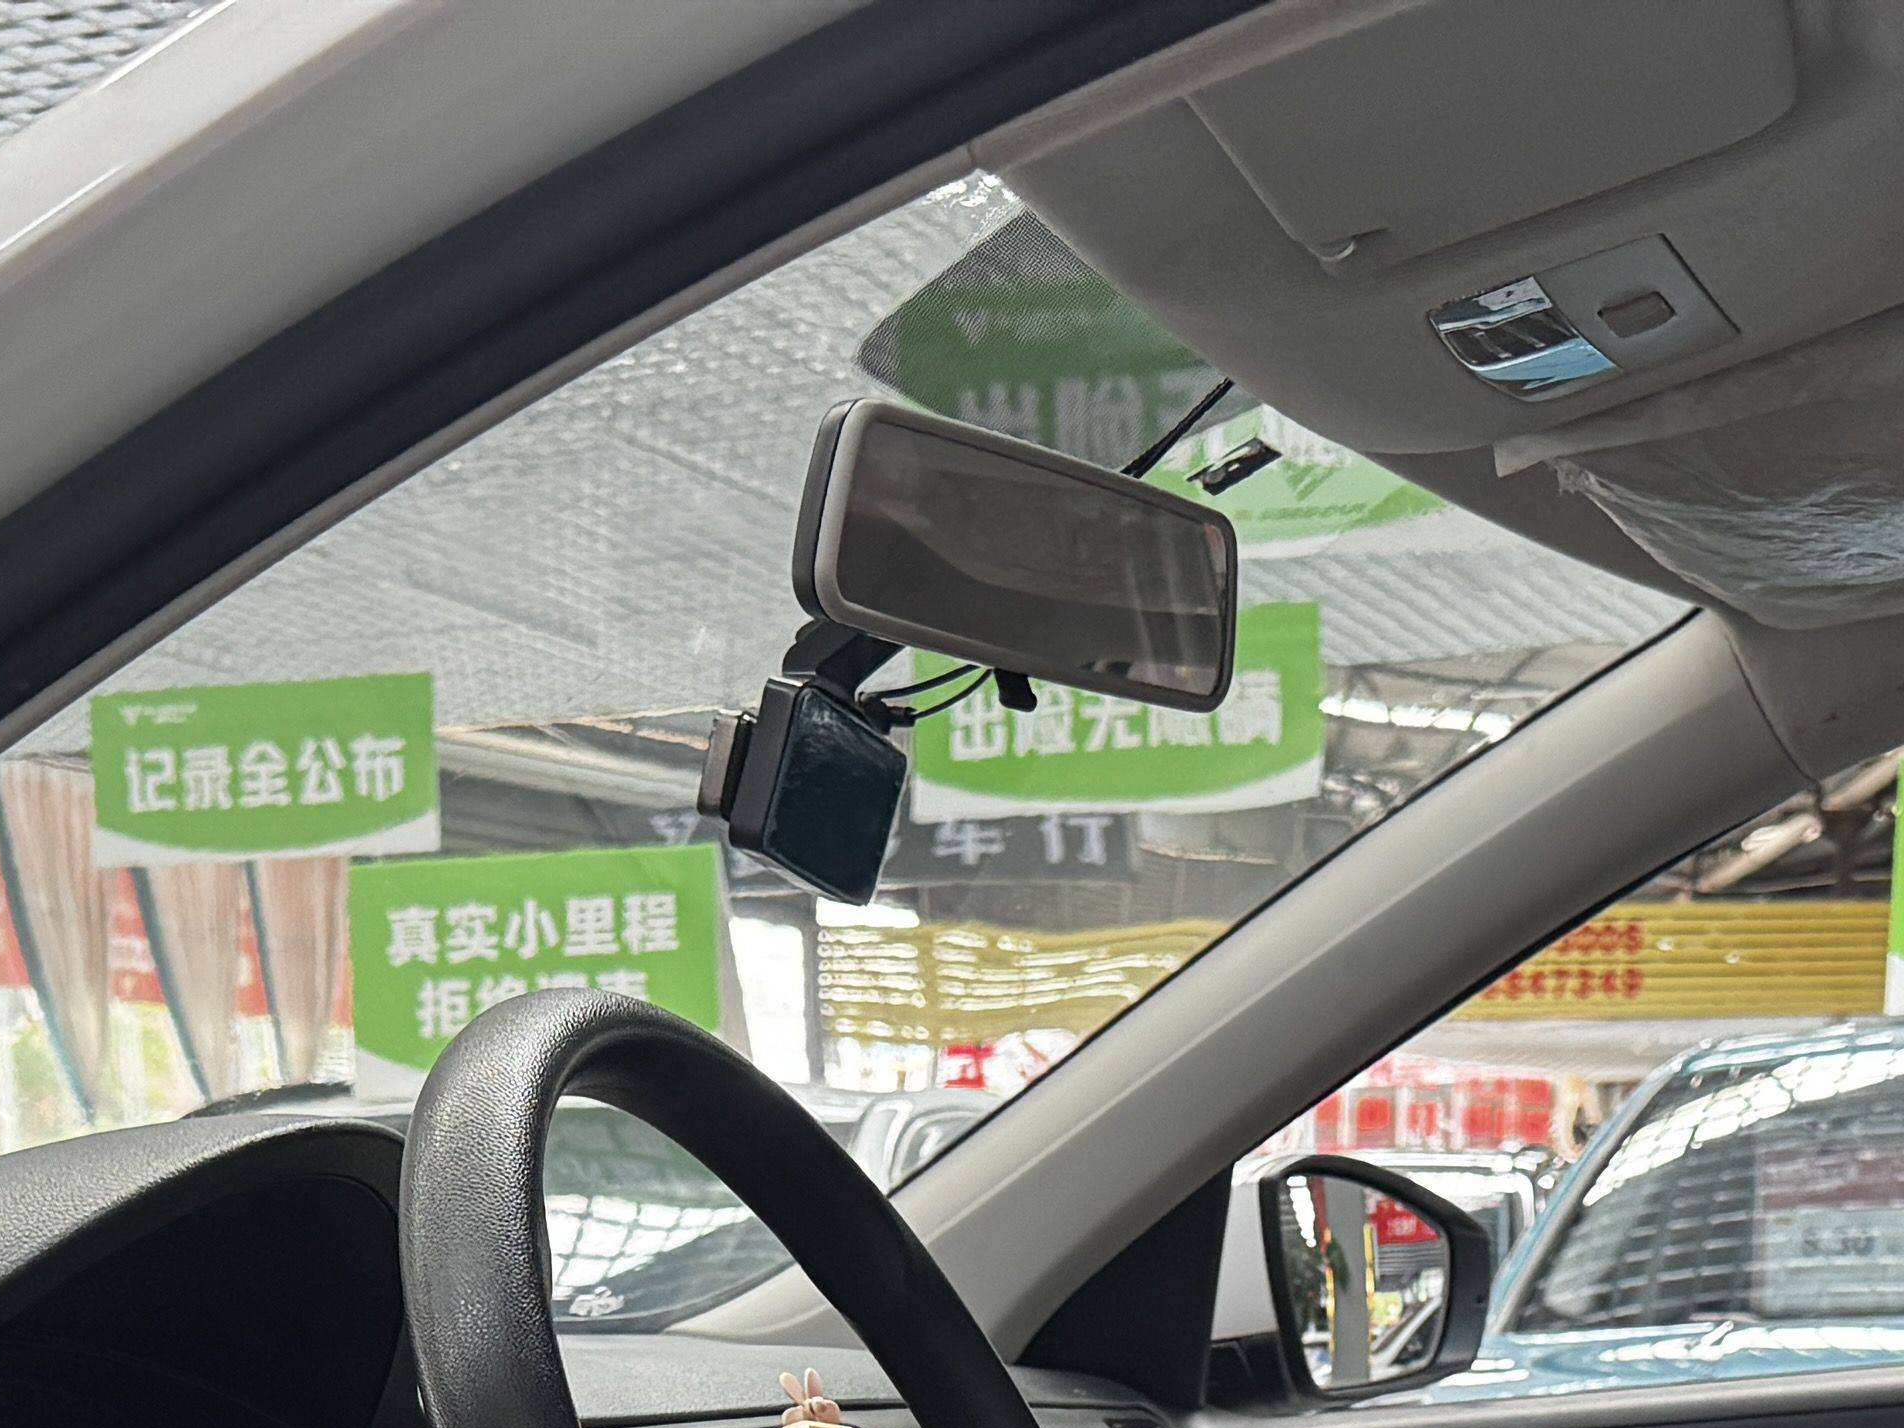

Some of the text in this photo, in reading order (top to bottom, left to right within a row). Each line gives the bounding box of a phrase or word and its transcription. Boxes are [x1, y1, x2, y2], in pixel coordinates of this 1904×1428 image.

[124, 735, 407, 813] 记录全公布
[386, 893, 680, 968] 真实小里程
